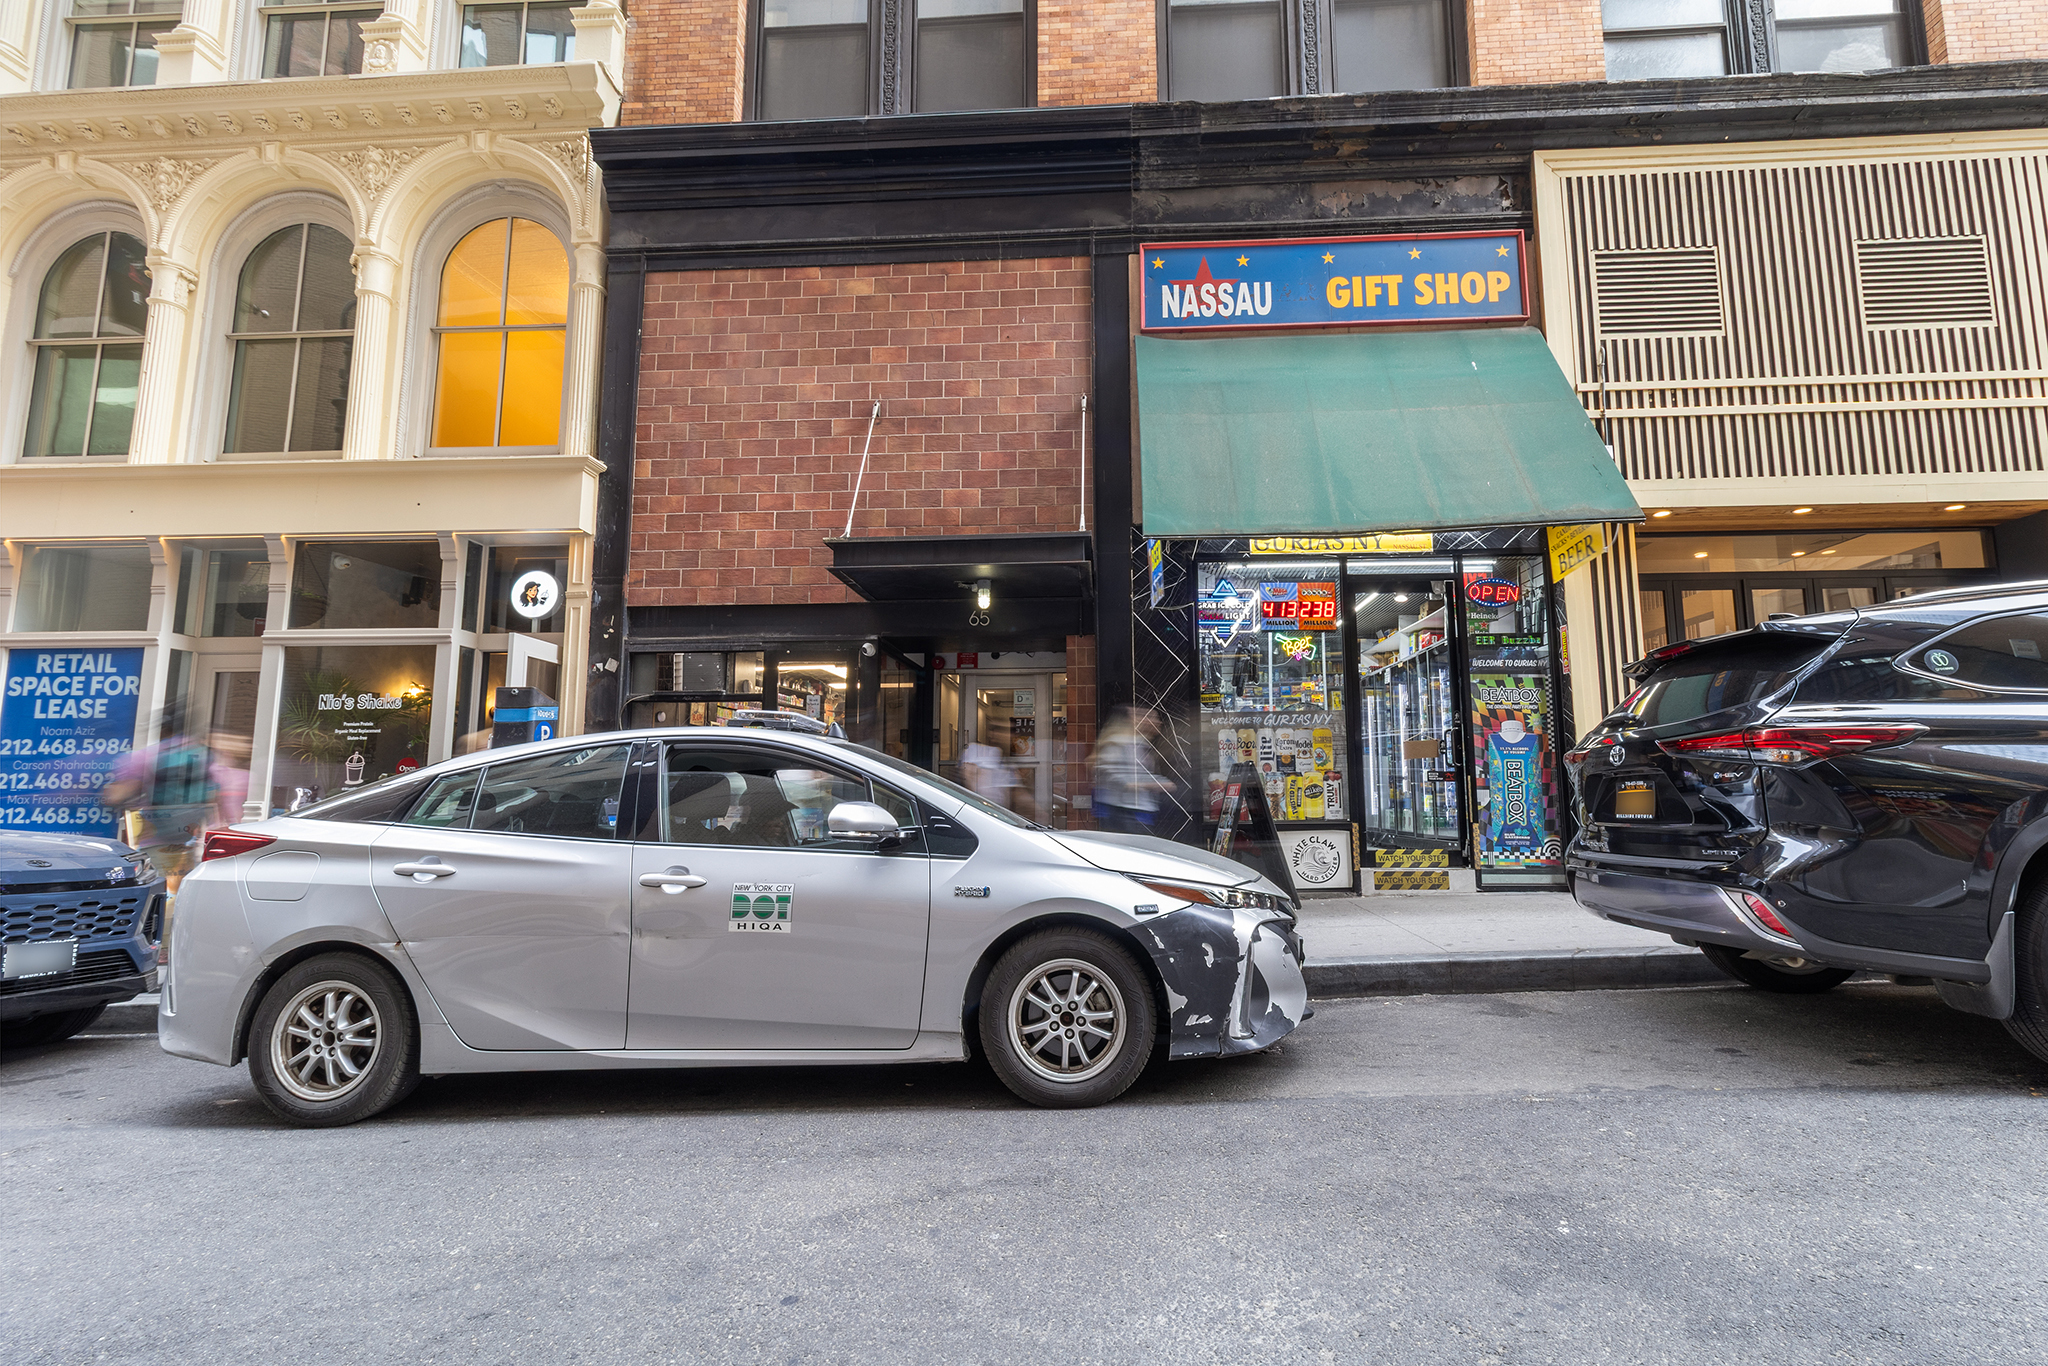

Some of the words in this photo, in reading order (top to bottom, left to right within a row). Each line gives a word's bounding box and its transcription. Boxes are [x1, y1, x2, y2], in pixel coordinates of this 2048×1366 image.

[1162, 281, 1272, 318] NASSAU
[1326, 274, 1403, 308] GIFT
[1414, 270, 1511, 305] SHOP
[1254, 537, 1345, 551] GURIAS
[1353, 534, 1383, 550] NY
[1557, 534, 1596, 574] BEER
[1468, 584, 1519, 602] OPEN
[1225, 612, 1250, 620] LIGHT
[1263, 601, 1297, 618] 413
[1300, 601, 1335, 618] 238
[968, 610, 990, 627] 65
[1282, 635, 1312, 657] Beer
[36, 653, 117, 673] RETAIL
[1472, 659, 1503, 667] WELCOME
[1504, 659, 1513, 667] TO
[1513, 659, 1538, 667] GURIAS
[1538, 659, 1547, 667] NY
[7, 676, 86, 696] SPACE
[89, 675, 140, 696] FOR
[318, 693, 354, 710] Nio's
[357, 693, 402, 710] Shake
[1017, 695, 1024, 703] D
[1480, 686, 1541, 703] BEATBOX
[33, 698, 108, 719] LEASE
[1211, 716, 1251, 725] WELCOME
[1252, 716, 1261, 725] TO
[1263, 713, 1310, 726] GURIAS
[1312, 713, 1333, 725] NY
[40, 726, 73, 736] Noam
[74, 726, 96, 736] Aziz
[541, 725, 551, 742] P
[1, 738, 133, 755] 212.468.5984
[1259, 736, 1273, 760] Lite
[13, 760, 50, 771] Carson
[53, 759, 115, 770] Shahrabani
[0, 772, 116, 790] 212.468.592
[7, 795, 30, 806] Max
[30, 794, 108, 807] Freudenberge
[1326, 783, 1335, 809] TRULY
[1505, 760, 1526, 824] BEATBOX
[1289, 790, 1298, 815] TWISTED
[0, 807, 122, 825] 12.468.5951
[1292, 839, 1308, 868] WHITE
[1309, 836, 1336, 851] CLAW
[1378, 854, 1404, 862] WATCH
[1405, 854, 1427, 862] YOUR
[1428, 854, 1446, 862] STEP
[1301, 871, 1319, 881] HARD
[1321, 856, 1338, 880] SELTZER
[753, 884, 773, 892] YORK
[776, 884, 792, 892] CITY
[1376, 876, 1403, 884] WATCH
[1405, 876, 1427, 884] YOUR
[1428, 876, 1447, 884] STEP
[732, 893, 791, 920] DOT
[737, 922, 782, 931] HIQA
